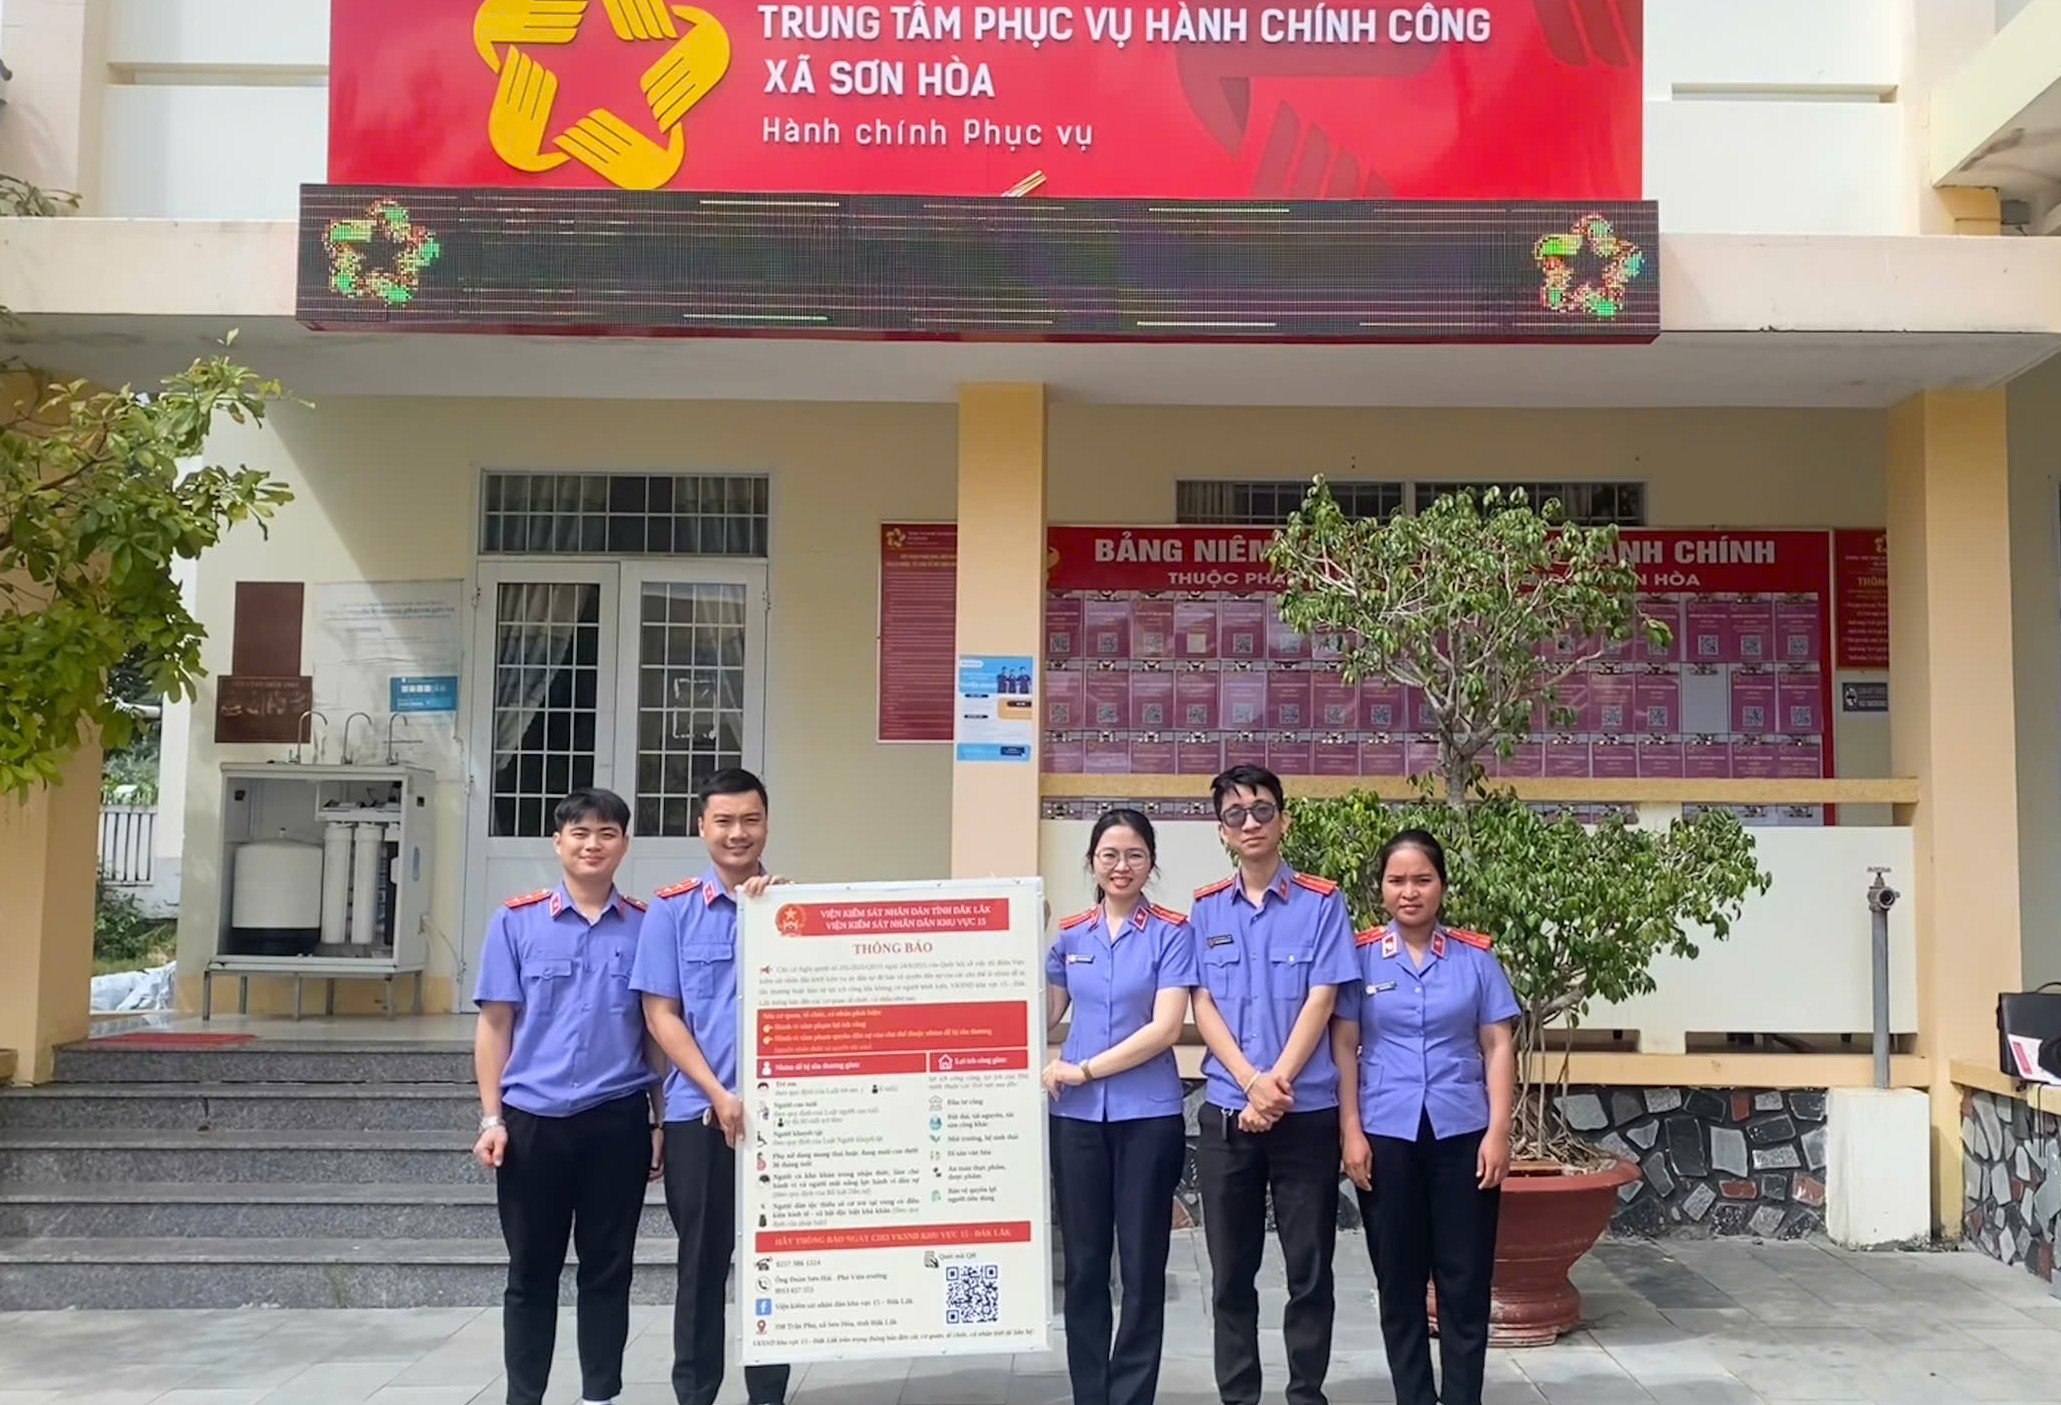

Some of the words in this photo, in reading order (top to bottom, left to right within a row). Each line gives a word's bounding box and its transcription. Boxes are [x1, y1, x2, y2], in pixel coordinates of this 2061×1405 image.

[757, 5, 880, 41] TRUNG
[891, 0, 962, 41] TÂM
[976, 6, 1073, 49] PHỤC
[1085, 6, 1131, 50] VỤ
[1146, 2, 1246, 42] HÀNH
[1261, 3, 1375, 42] CHÍNH
[1389, 2, 1490, 43] CÔNG
[764, 54, 816, 95] XÃ
[831, 57, 904, 96] SƠN
[918, 55, 995, 98] HÒA
[763, 116, 840, 144] Hành
[857, 118, 947, 146] chính
[964, 118, 1043, 151] Phục
[1058, 125, 1093, 151] vụ
[1095, 531, 1182, 562] BẢNG
[1674, 536, 1776, 564] CHÍNH
[1168, 569, 1239, 588] THUỘC
[1655, 570, 1701, 586] HÒA
[853, 941, 902, 955] THÔNG
[906, 939, 933, 953] BÁO
